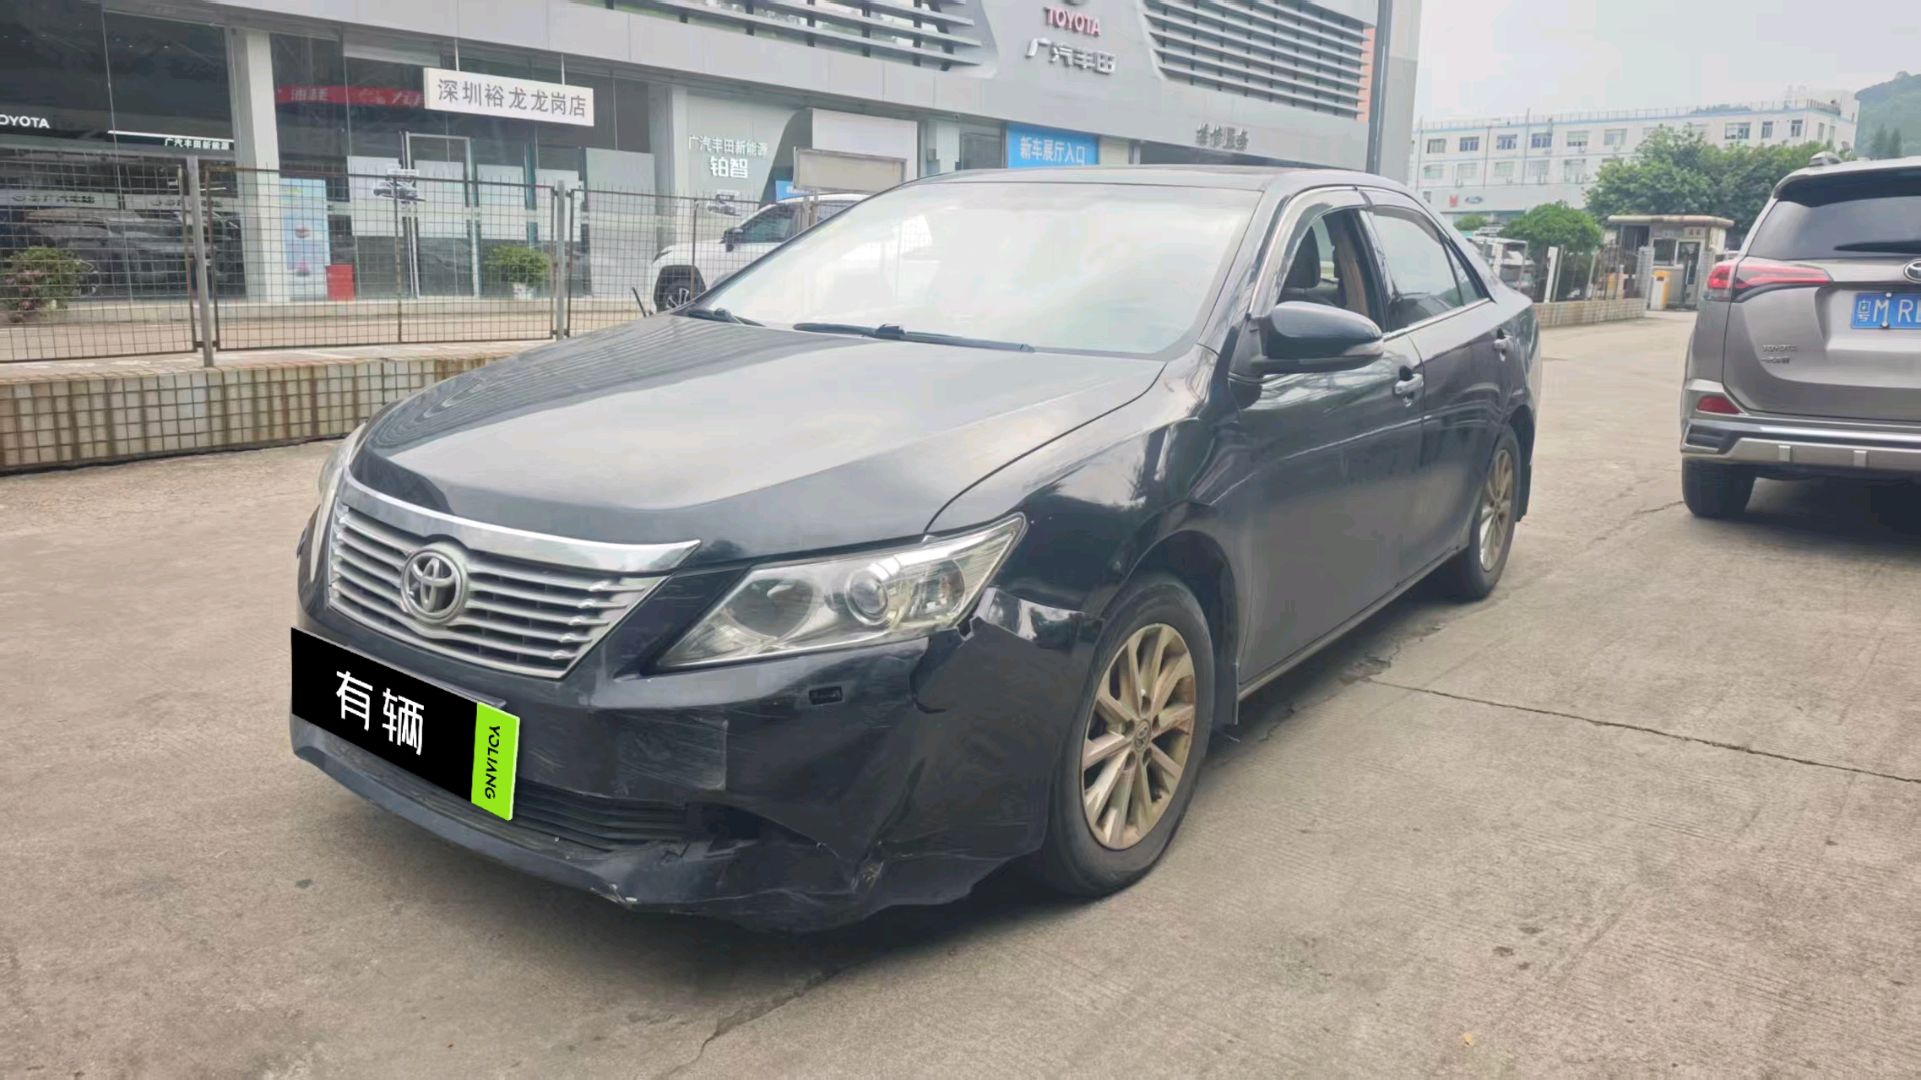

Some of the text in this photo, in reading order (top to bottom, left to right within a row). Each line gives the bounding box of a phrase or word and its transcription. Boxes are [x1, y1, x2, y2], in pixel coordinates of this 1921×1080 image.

[1043, 7, 1101, 37] TOYOTA
[1025, 38, 1116, 75] 广汽丰田
[438, 78, 586, 118] 深圳裕龙龙岗店
[688, 135, 768, 156] 广汽丰田新能源
[1020, 136, 1085, 164] 新车展厅入口
[710, 155, 748, 179] 铂智
